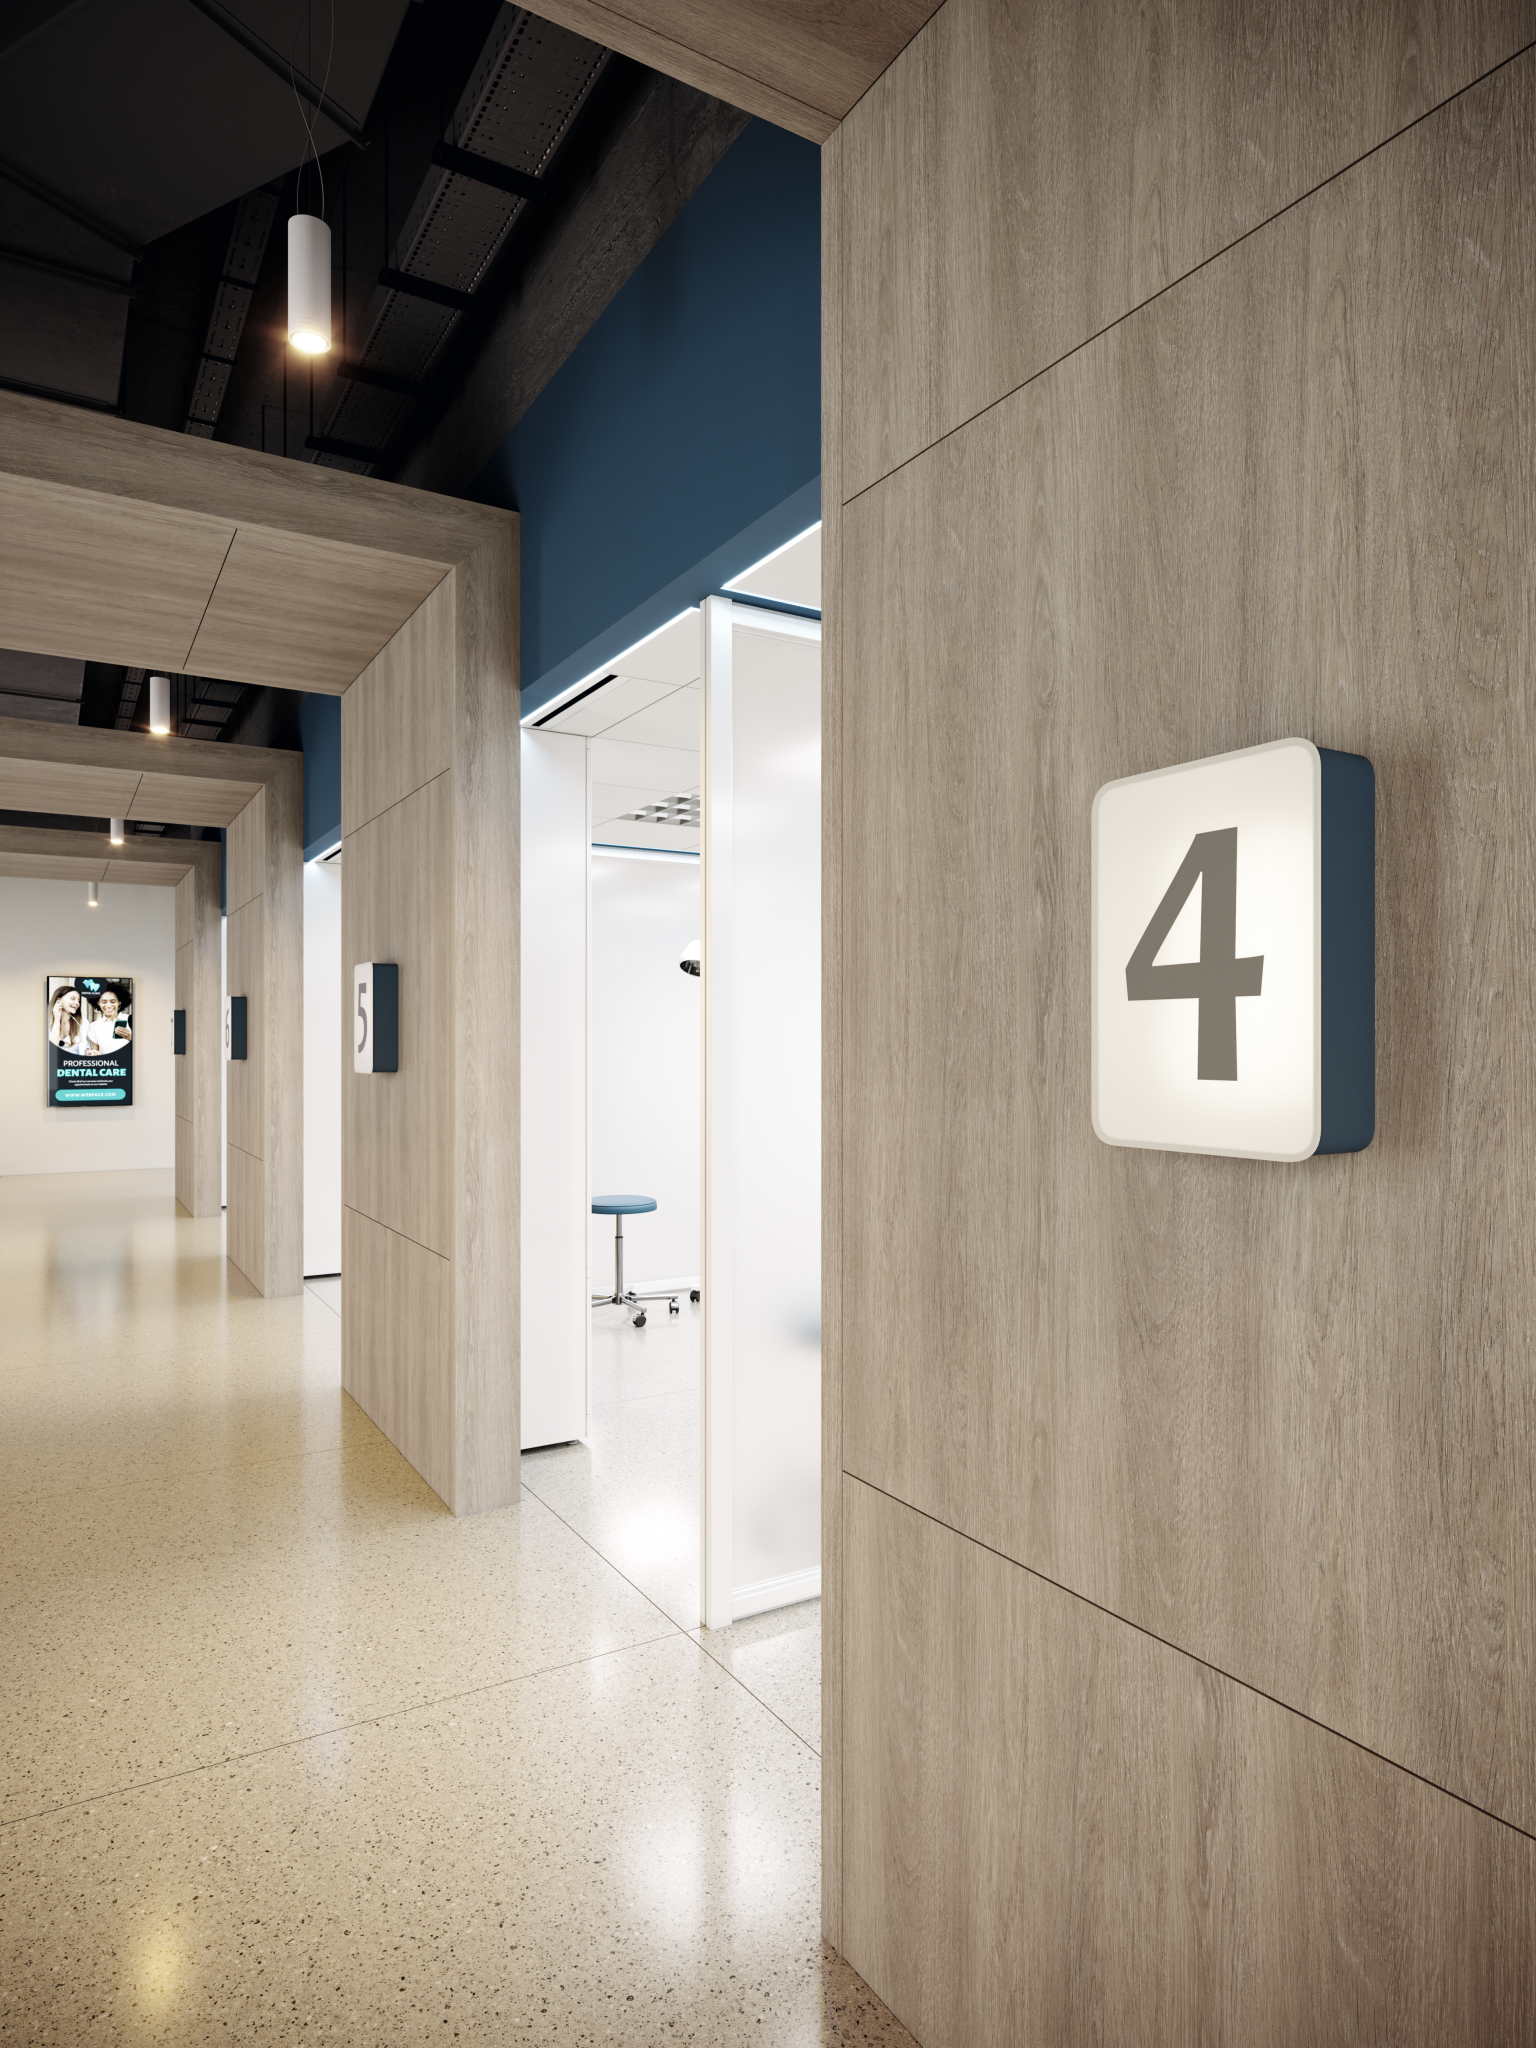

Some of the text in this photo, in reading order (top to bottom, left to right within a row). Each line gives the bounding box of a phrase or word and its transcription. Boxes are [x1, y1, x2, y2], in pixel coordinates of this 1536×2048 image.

[1125, 827, 1264, 1081] 4
[358, 982, 368, 1054] 5
[57, 1068, 126, 1077] DENTAL CARE
